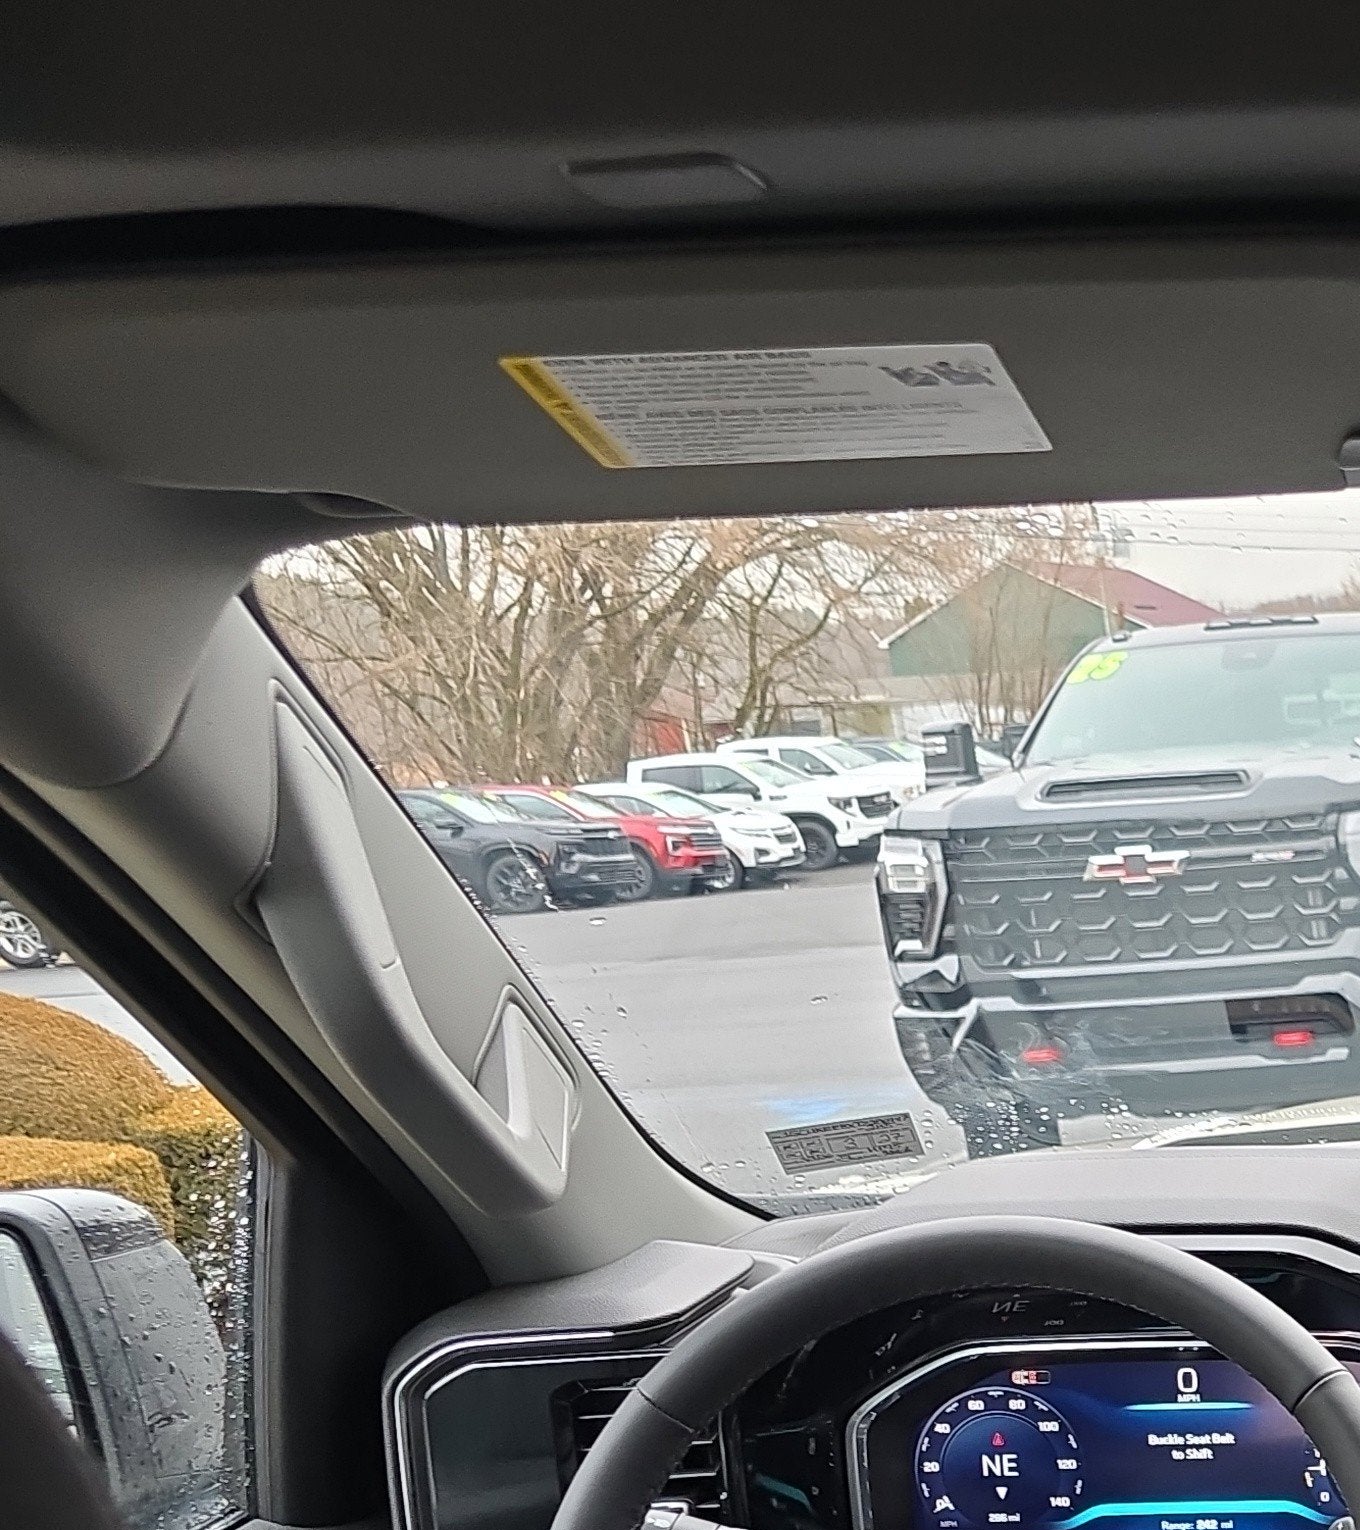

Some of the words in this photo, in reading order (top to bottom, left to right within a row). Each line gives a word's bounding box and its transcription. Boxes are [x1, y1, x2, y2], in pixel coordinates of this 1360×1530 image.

[1177, 1367, 1199, 1393] 0
[1147, 1434, 1186, 1445] Buckle
[1186, 1434, 1212, 1445] Seat
[1211, 1433, 1236, 1445] Belt
[1171, 1450, 1185, 1461] to
[1185, 1449, 1215, 1460] Shift
[923, 1461, 940, 1473] 20
[981, 1454, 1020, 1477] NE
[1057, 1459, 1078, 1470] 120
[1050, 1496, 1071, 1507] 140
[1220, 1520, 1233, 1530] mi
